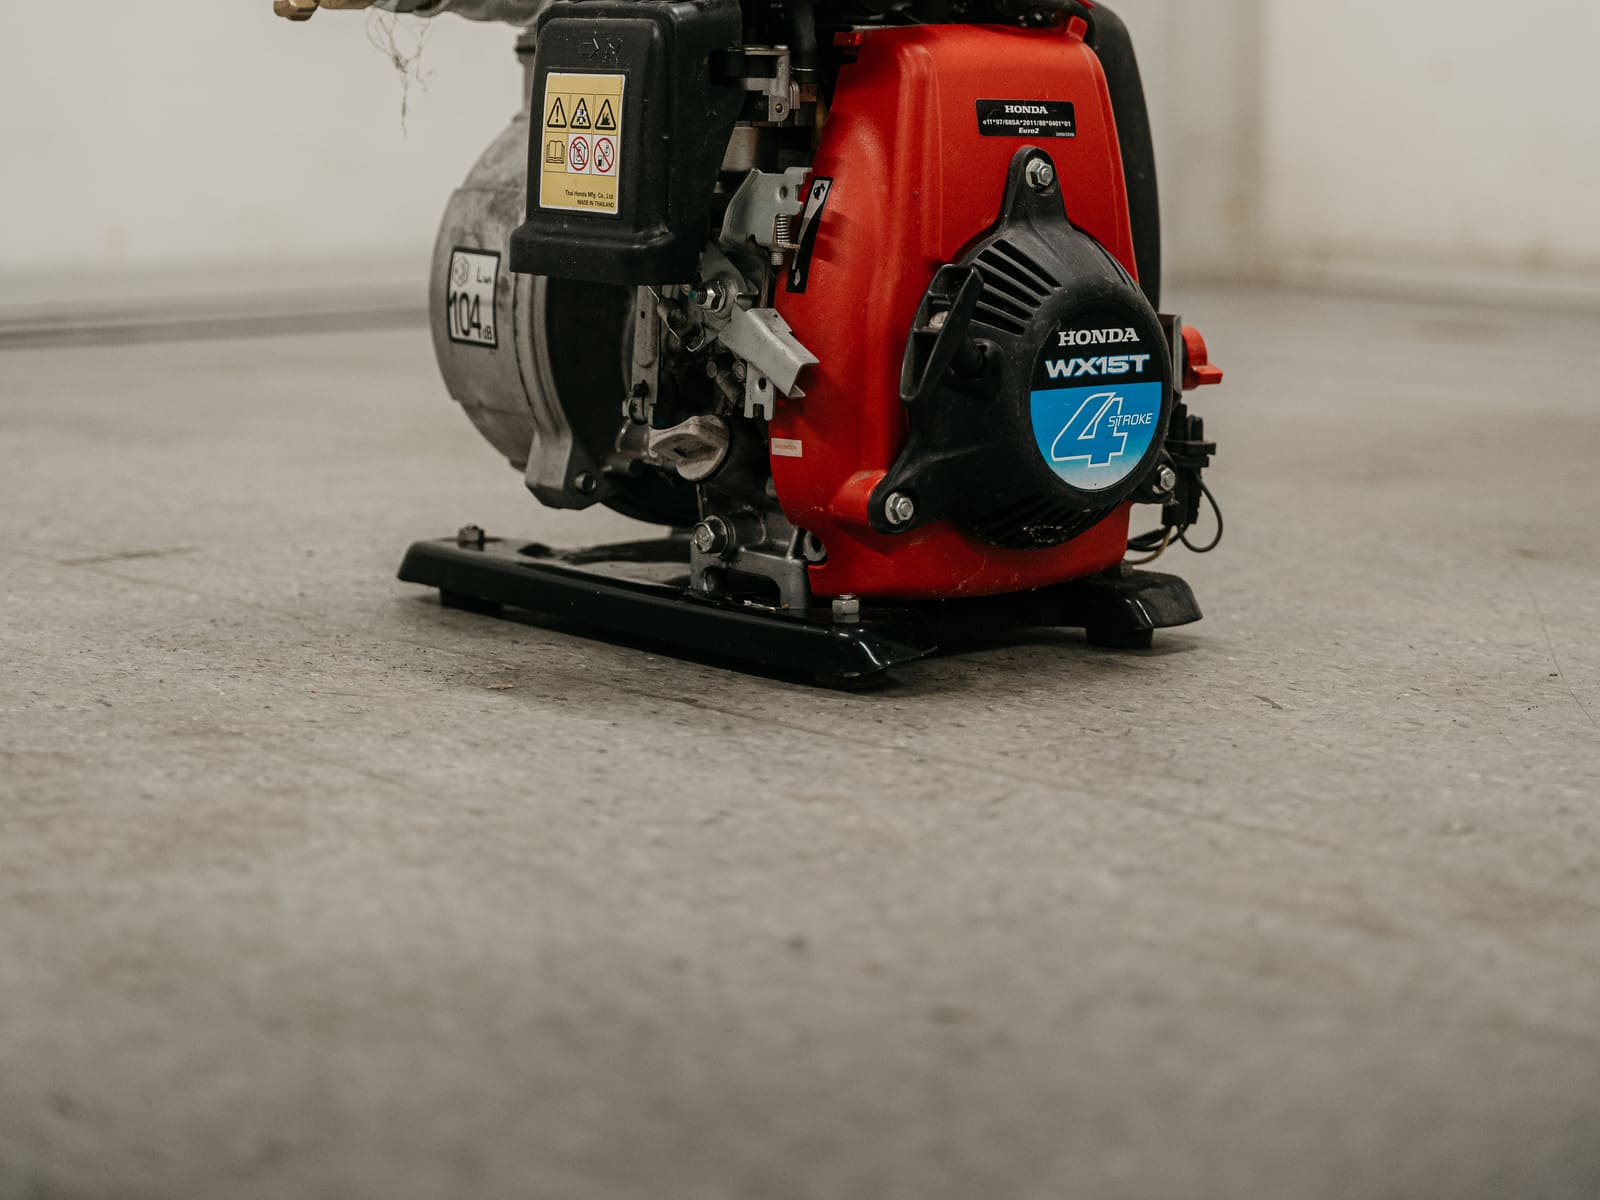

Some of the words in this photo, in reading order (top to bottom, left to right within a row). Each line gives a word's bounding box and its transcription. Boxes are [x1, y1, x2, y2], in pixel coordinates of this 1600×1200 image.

[1004, 105, 1048, 114] HONDA
[448, 291, 481, 339] 104
[1058, 328, 1140, 346] HONDA
[1045, 354, 1150, 378] WX15T
[1051, 392, 1129, 468] 4
[1107, 413, 1153, 428] STROKE
